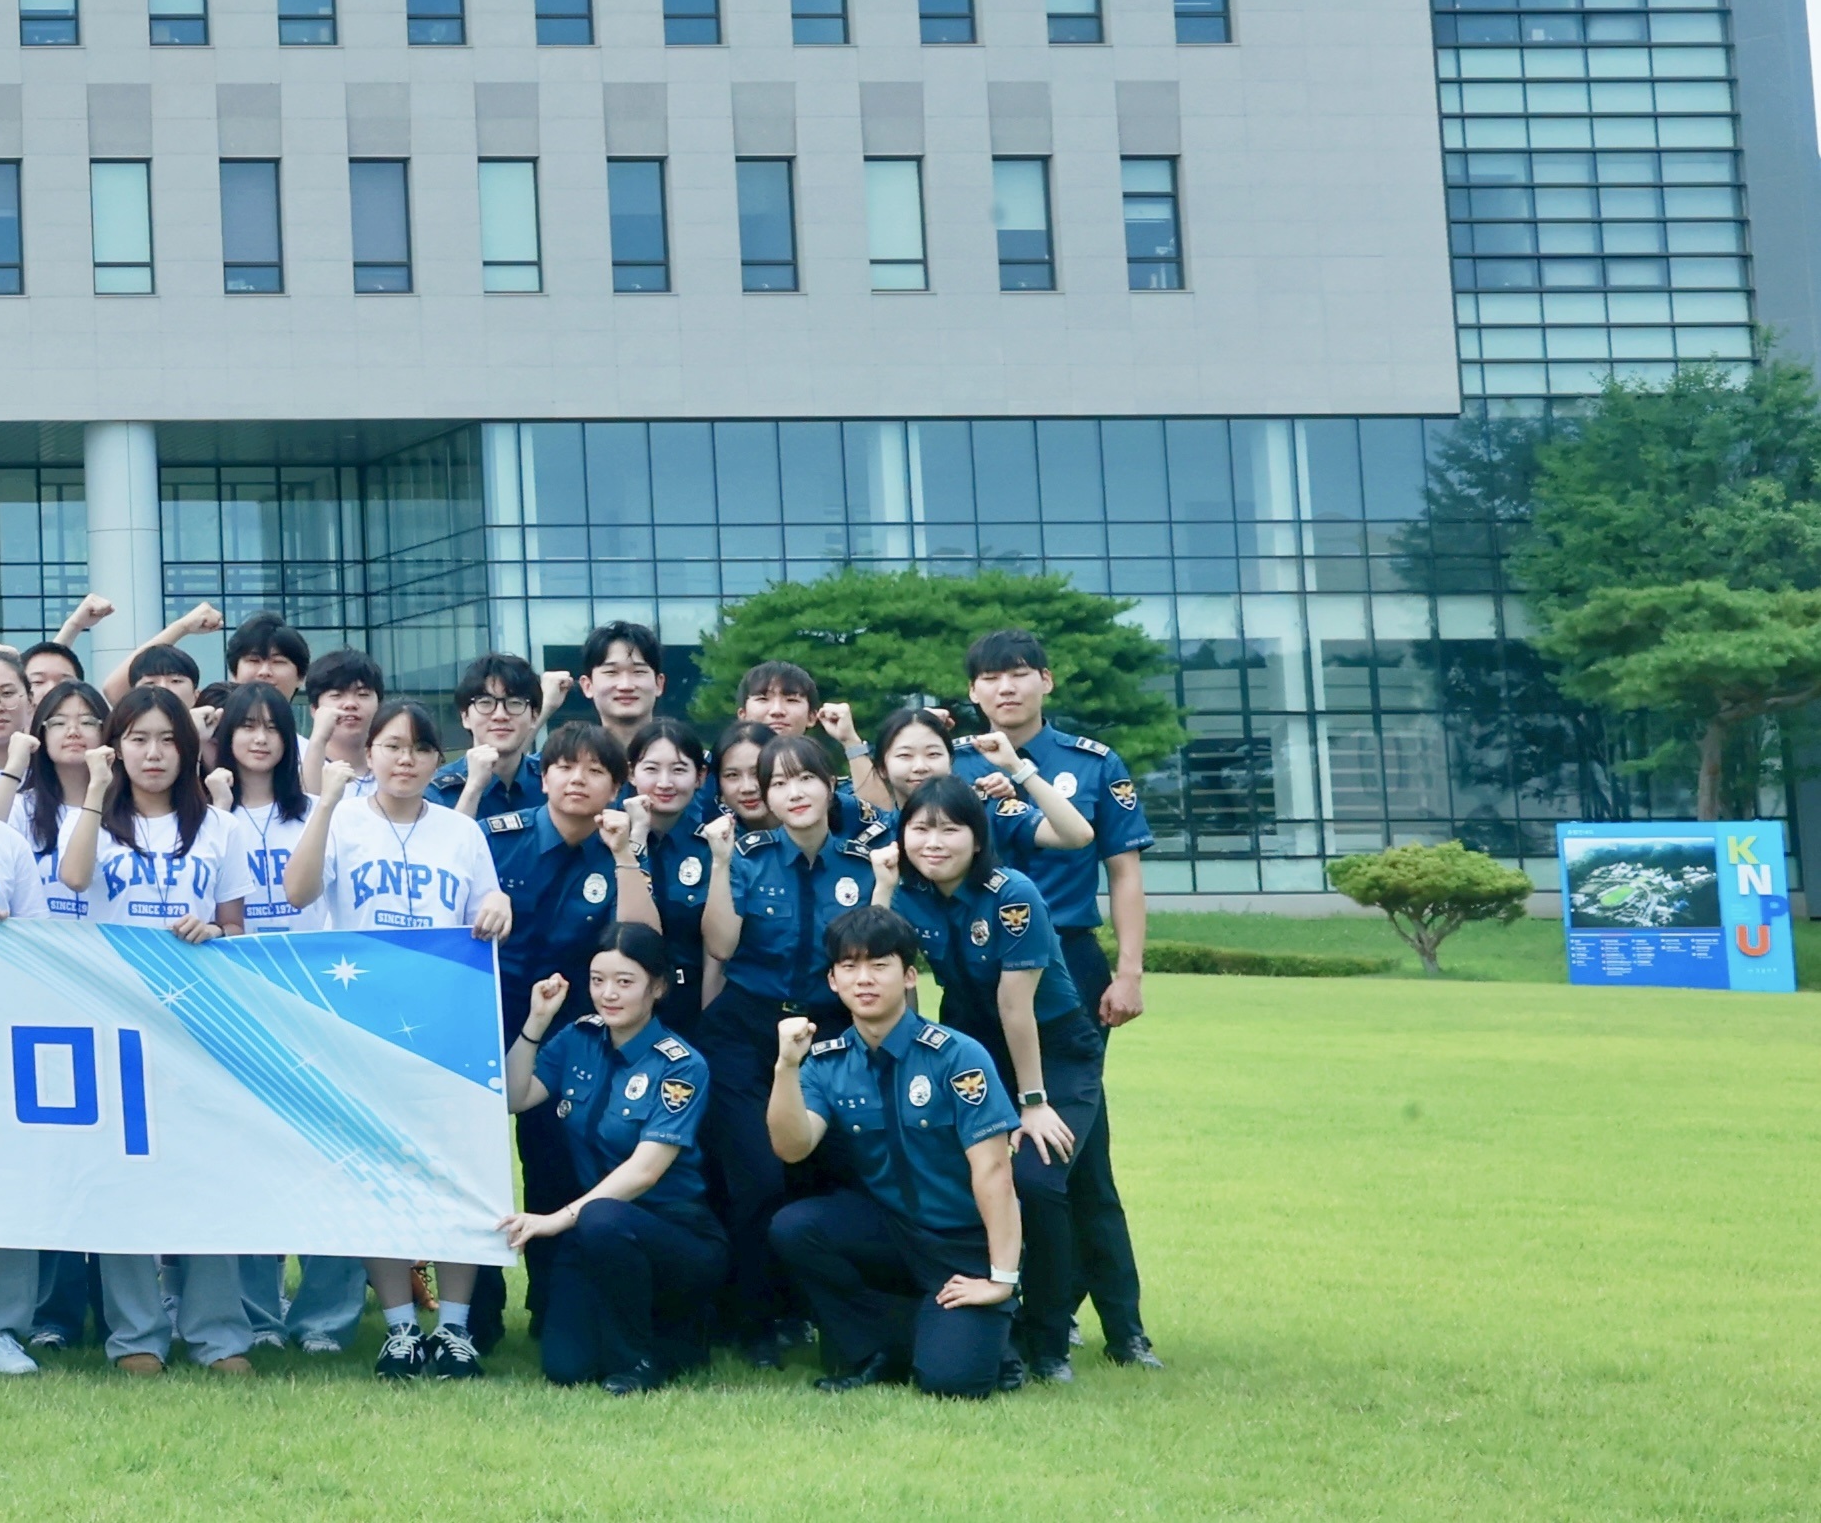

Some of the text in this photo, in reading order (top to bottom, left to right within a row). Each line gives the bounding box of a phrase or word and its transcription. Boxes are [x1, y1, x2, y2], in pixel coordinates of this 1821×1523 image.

[103, 848, 211, 901] KNPU
[247, 849, 292, 887] NP
[350, 859, 459, 912] KNPU
[131, 904, 160, 915] SINCE
[377, 913, 405, 925] SINCE
